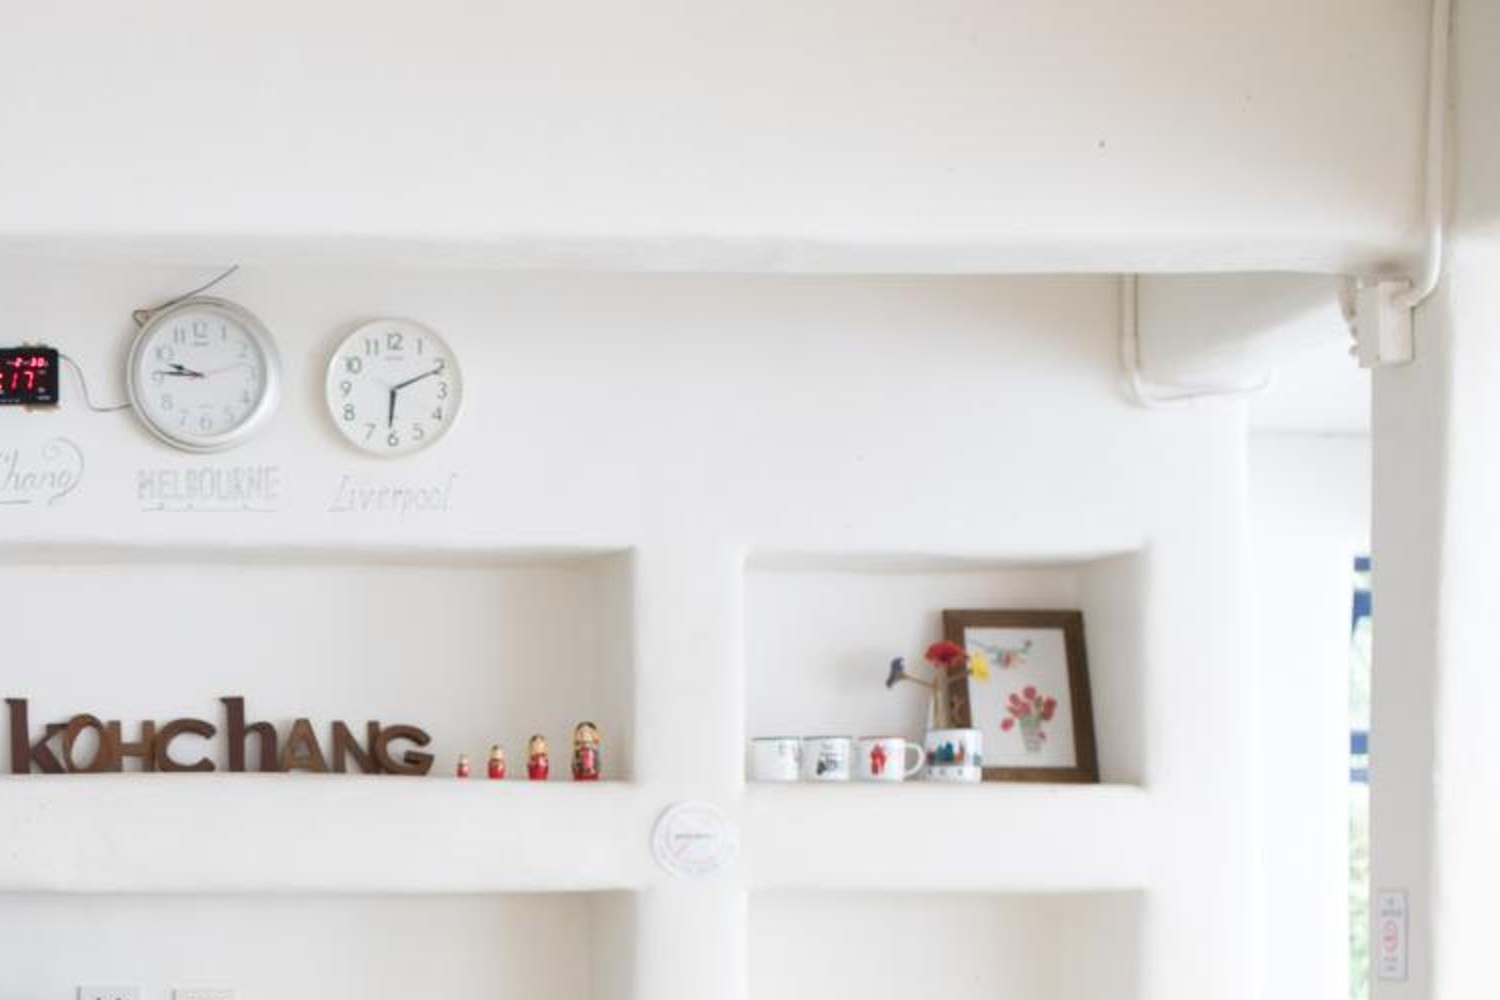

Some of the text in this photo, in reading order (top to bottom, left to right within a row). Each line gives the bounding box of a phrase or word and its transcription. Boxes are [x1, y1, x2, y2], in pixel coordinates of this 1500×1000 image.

[365, 338, 379, 355] 11
[387, 333, 403, 351] 12
[344, 355, 362, 374] 10
[340, 380, 352, 397] 9
[437, 382, 448, 399] 3
[343, 403, 355, 421] 8
[431, 405, 443, 420] 4
[365, 423, 377, 440] 7
[387, 428, 399, 446] 6
[412, 422, 425, 440] 5
[137, 465, 280, 500] MELBOURNE
